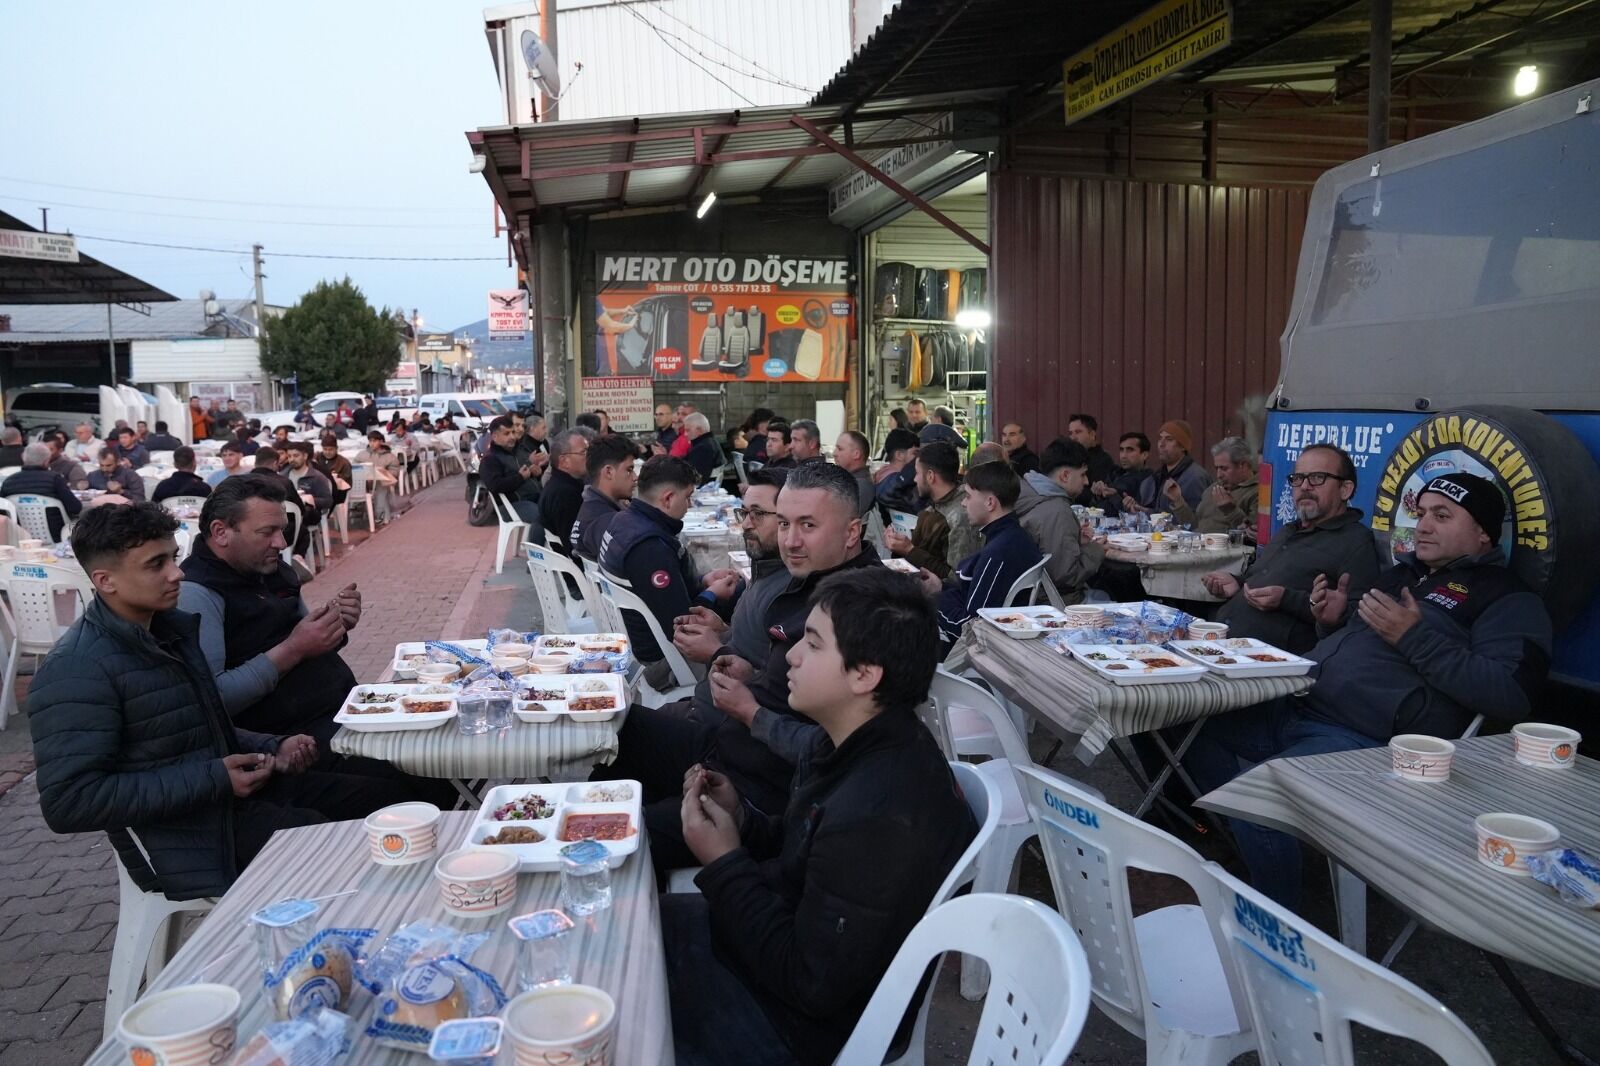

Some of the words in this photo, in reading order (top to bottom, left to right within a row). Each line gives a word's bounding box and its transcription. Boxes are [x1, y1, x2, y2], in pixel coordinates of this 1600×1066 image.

[1093, 29, 1137, 87] ÖZDEMİR
[1137, 24, 1152, 57] OTO
[1153, 2, 1190, 46] KAPORTA
[1098, 84, 1115, 102] CAM
[1152, 62, 1163, 75] ve
[1164, 45, 1187, 69] KİLİT
[1190, 22, 1225, 55] TAMİRİ
[853, 175, 864, 195] OTO
[602, 256, 677, 281] MERT
[683, 257, 736, 283] OTO
[742, 254, 849, 287] DÖŞEME
[655, 284, 682, 292] Tamer
[711, 284, 718, 292] 0
[735, 284, 750, 292] 717
[750, 285, 760, 293] 12
[760, 285, 771, 293] 33
[587, 390, 610, 398] ALARM
[605, 379, 619, 388] OTO
[1277, 423, 1383, 454] DEEPBLUE
[1371, 514, 1390, 532] R
[1381, 429, 1425, 496] READY
[1427, 415, 1462, 449] FOR
[1462, 417, 1548, 551] ADVENTURE?
[1431, 478, 1465, 499] BLACK
[448, 883, 511, 908] Soup
